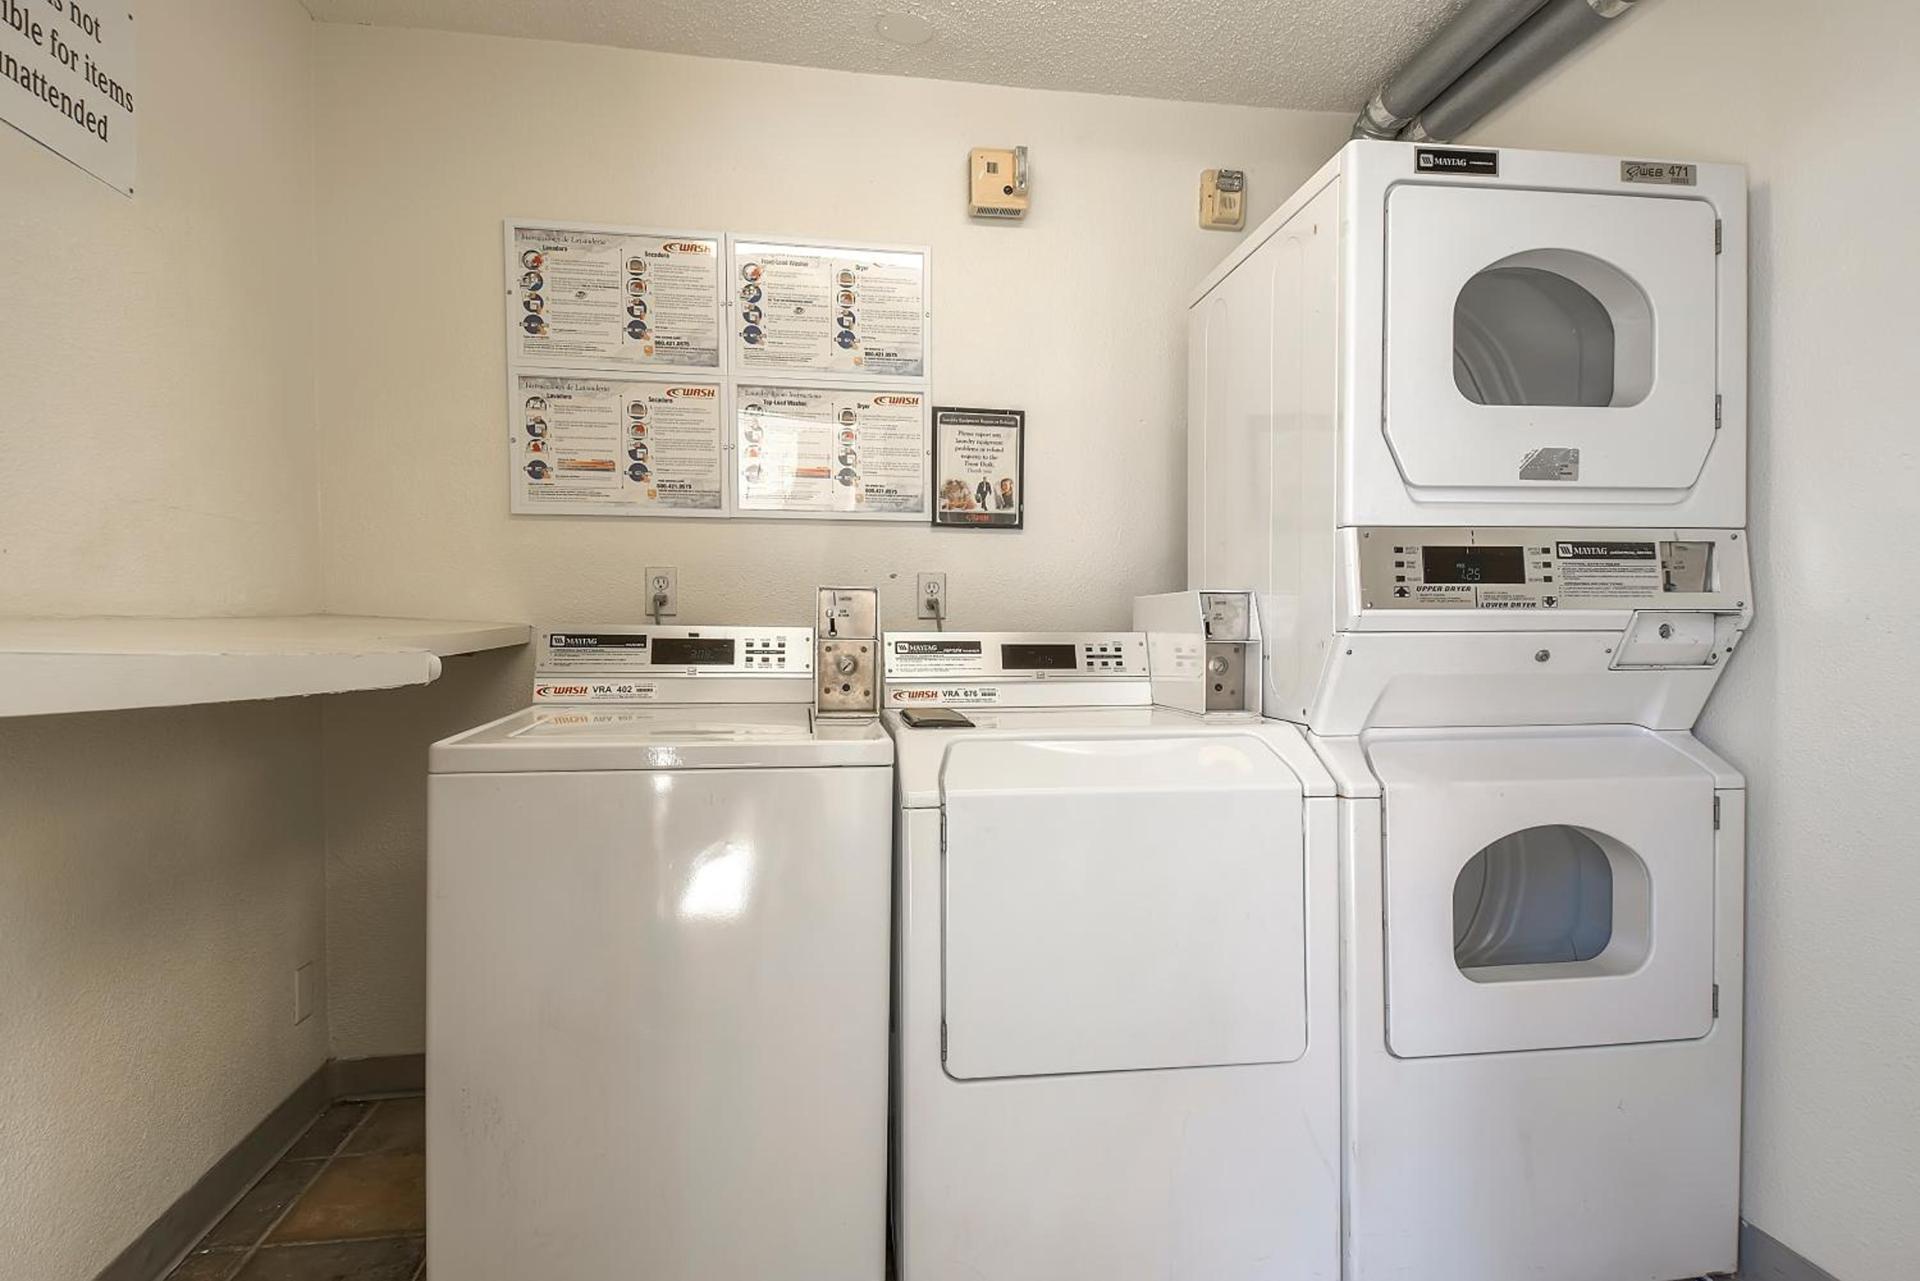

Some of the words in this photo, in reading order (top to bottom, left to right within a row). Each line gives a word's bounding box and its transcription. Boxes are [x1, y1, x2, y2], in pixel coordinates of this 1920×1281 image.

[48, 0, 63, 12] s
[70, 2, 102, 43] not
[50, 28, 78, 72] for
[85, 54, 134, 113] items
[1435, 158, 1467, 166] MAYTAG
[1640, 167, 1664, 177] WEB
[1669, 163, 1688, 177] 471
[682, 388, 715, 397] WASH
[888, 396, 919, 405] WASH
[1573, 546, 1607, 555] MAYTAG
[1481, 601, 1509, 609] LOWER
[1510, 601, 1537, 609] DRYER
[566, 637, 598, 645] MAYTAG
[909, 643, 938, 651] MAYTAG
[553, 686, 588, 695] WASH
[592, 686, 613, 694] VRA
[616, 685, 632, 694] 402
[908, 690, 938, 699] WASH
[942, 690, 960, 698] VRA
